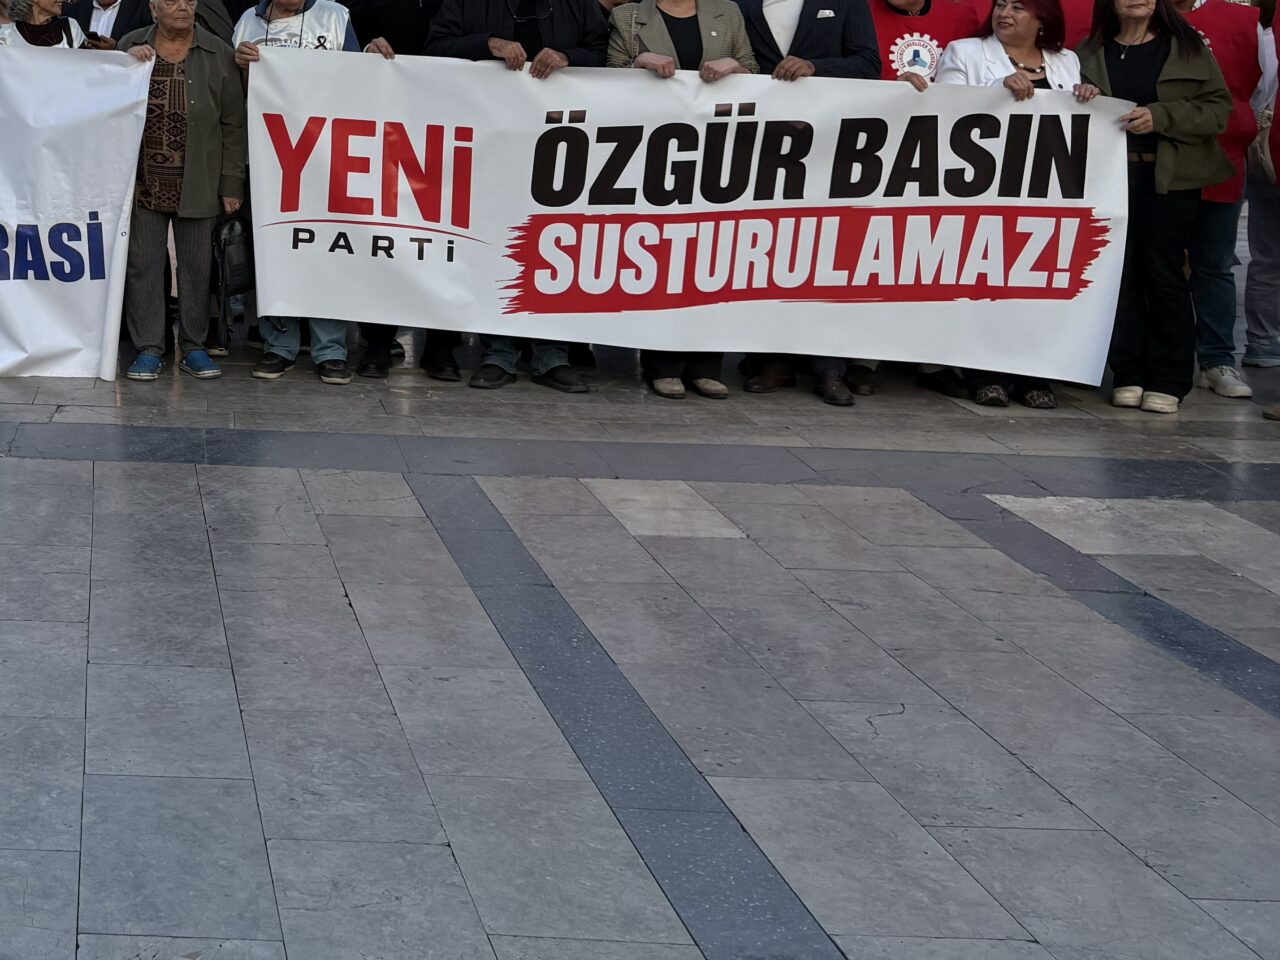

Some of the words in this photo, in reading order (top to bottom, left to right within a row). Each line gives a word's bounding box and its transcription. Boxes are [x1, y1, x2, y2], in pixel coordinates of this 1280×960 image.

[531, 102, 815, 207] ÖZGÜR
[829, 112, 1091, 200] BASIN
[535, 215, 1073, 297] SUSTURULAMAZ!
